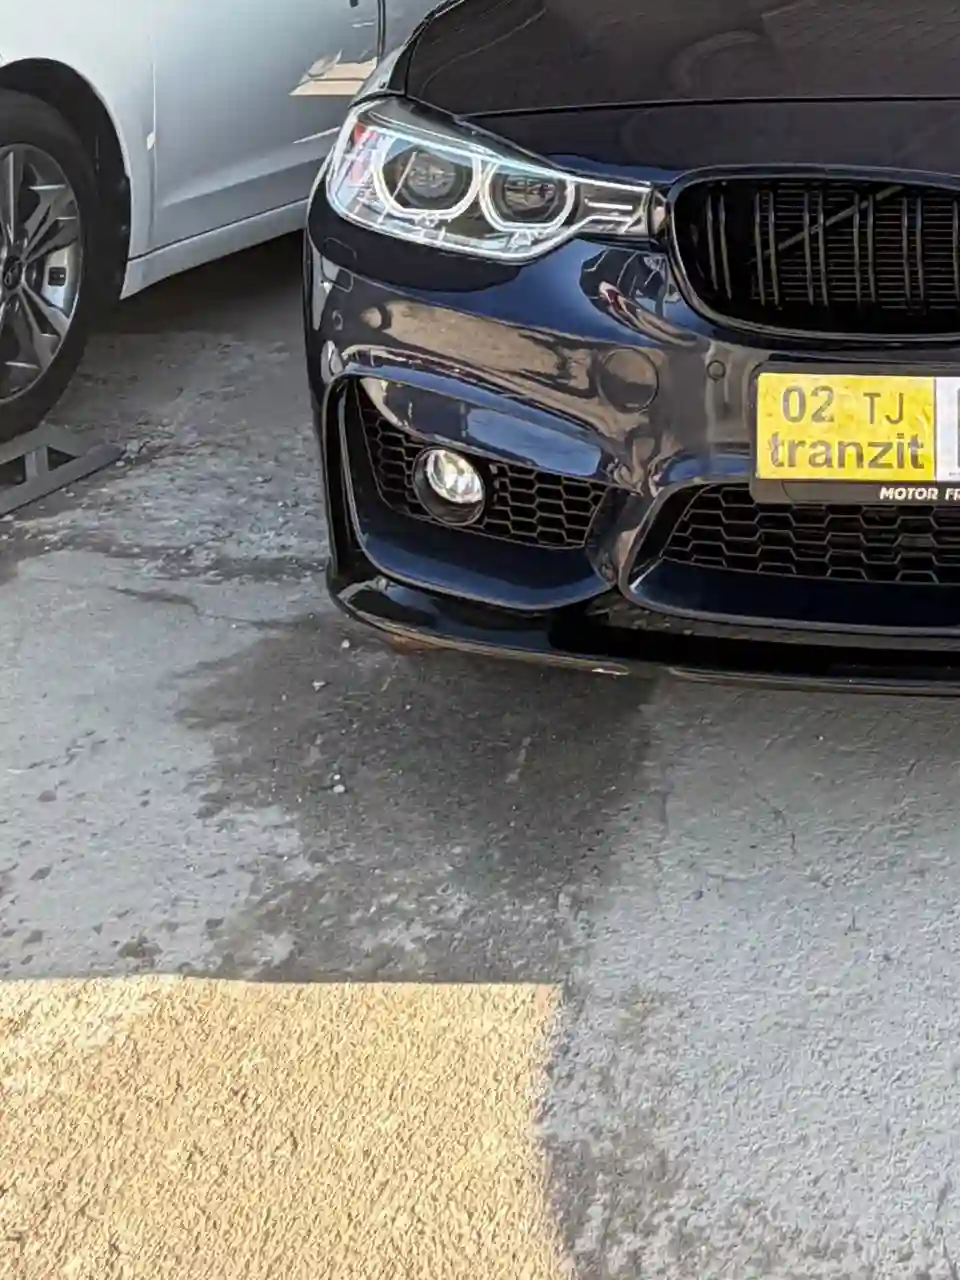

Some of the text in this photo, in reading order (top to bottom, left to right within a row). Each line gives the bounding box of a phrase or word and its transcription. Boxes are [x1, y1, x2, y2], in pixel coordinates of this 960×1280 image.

[782, 385, 905, 425] 02 TJ
[769, 431, 925, 470] tranzit
[879, 487, 938, 500] MOTOR
